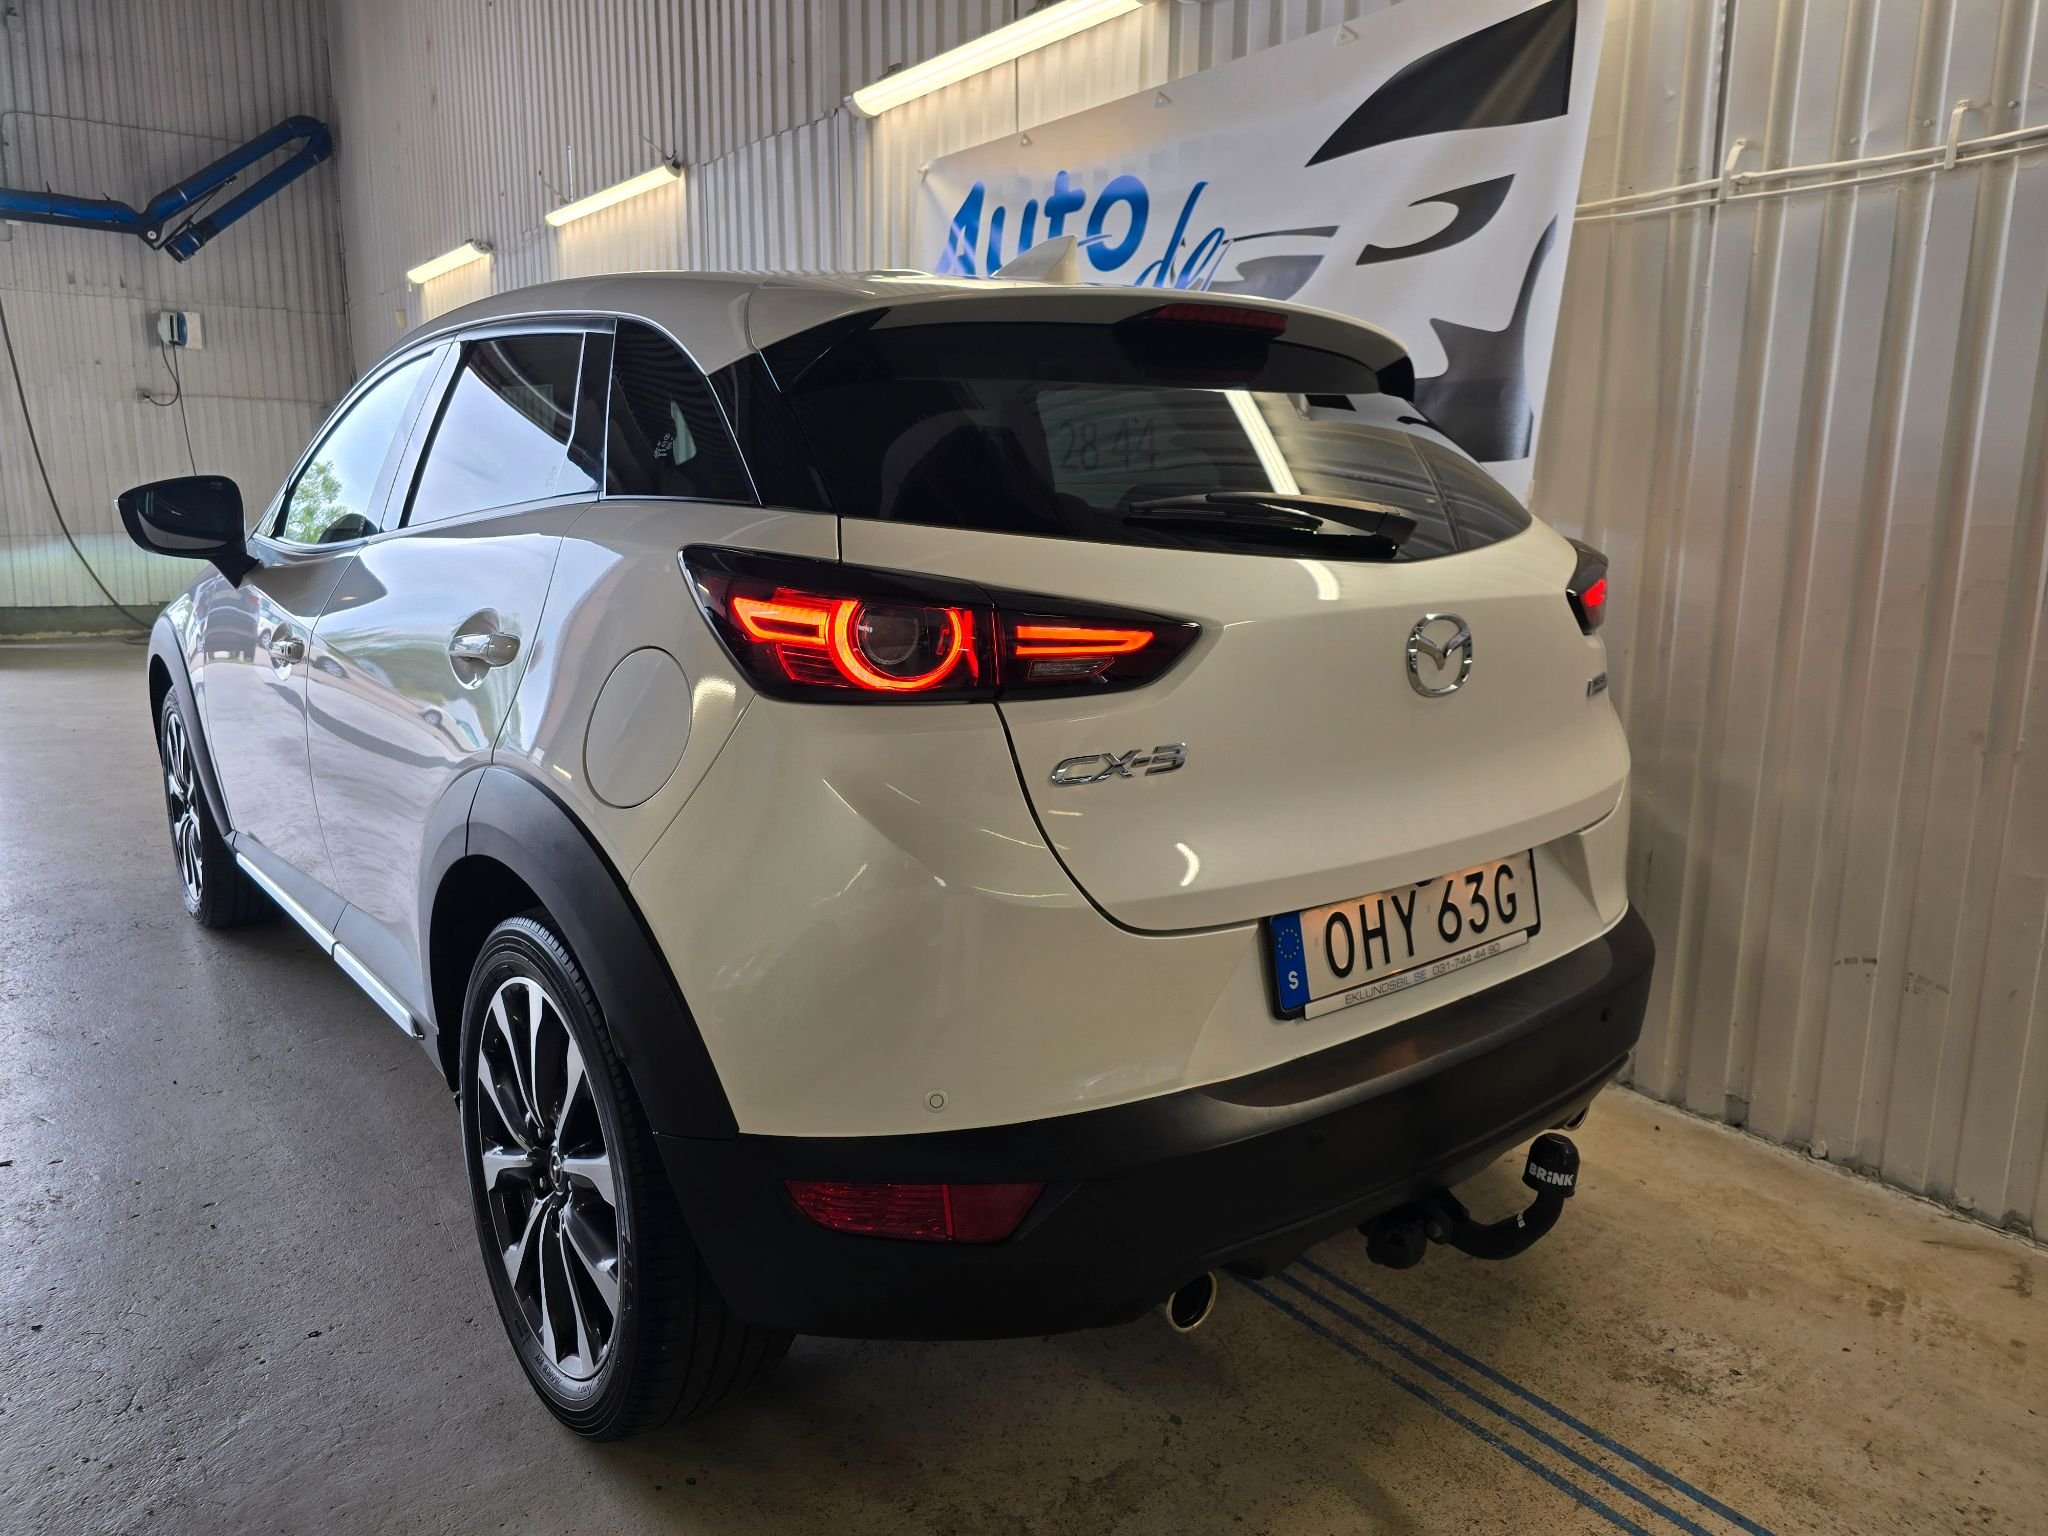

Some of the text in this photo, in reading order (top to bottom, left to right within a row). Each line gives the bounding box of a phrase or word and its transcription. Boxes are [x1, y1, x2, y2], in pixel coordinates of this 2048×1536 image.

[1050, 742, 1188, 787] CX-3
[1325, 864, 1518, 979] OHY 63G
[1288, 971, 1299, 990] S
